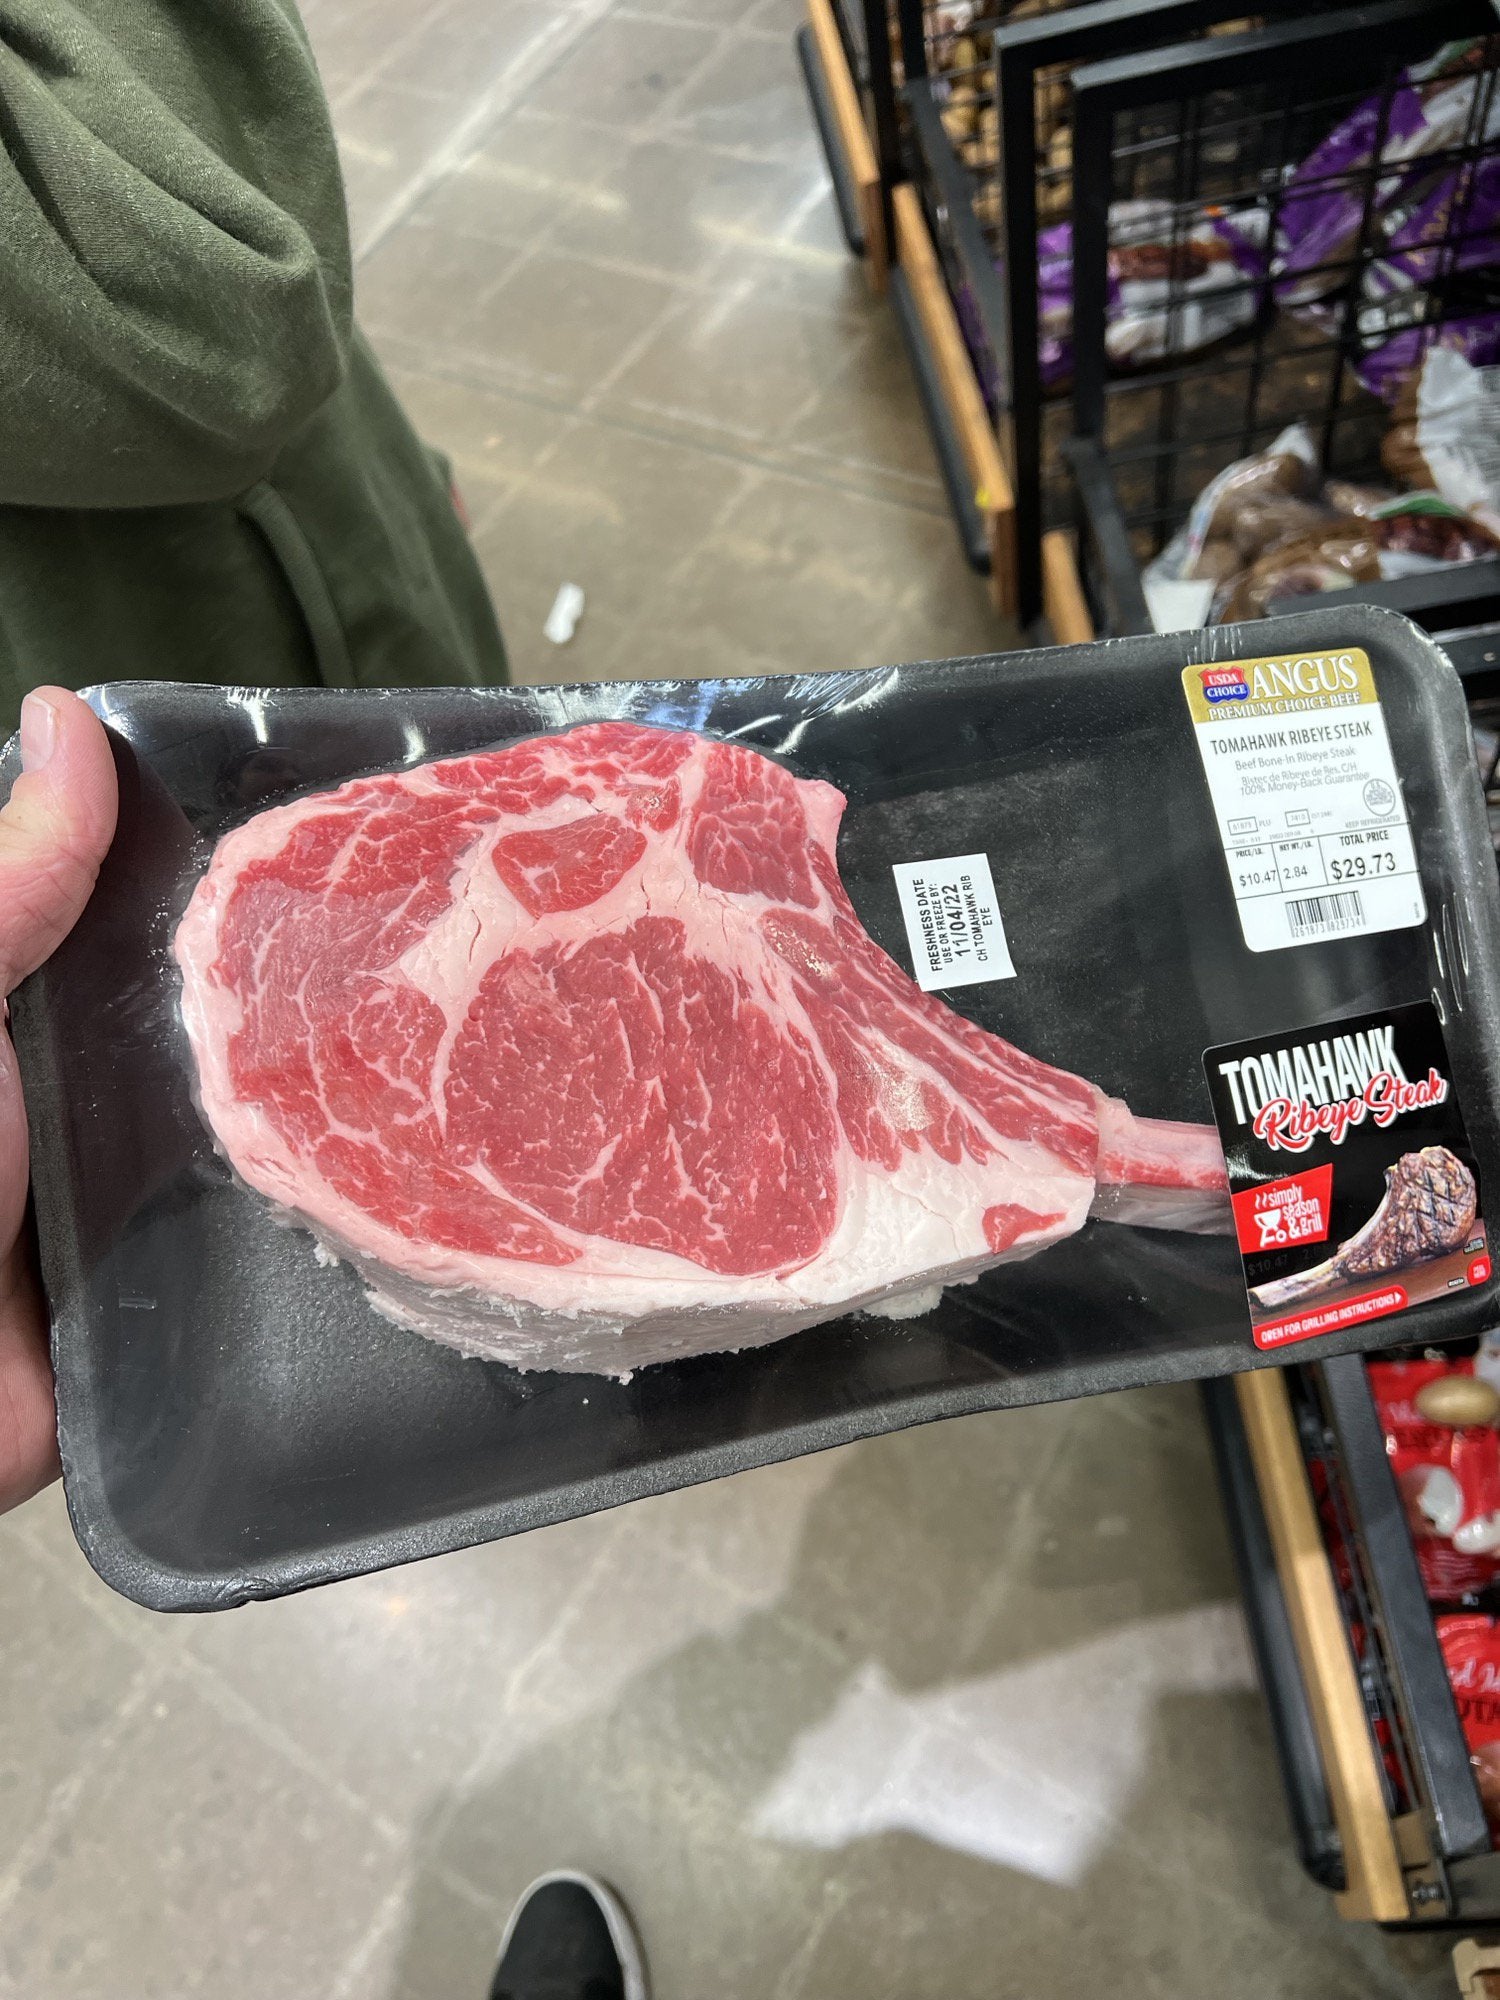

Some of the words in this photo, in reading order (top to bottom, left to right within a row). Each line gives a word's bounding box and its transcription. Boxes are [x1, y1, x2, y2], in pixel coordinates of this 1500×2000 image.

[1208, 674, 1239, 685] USDA
[1252, 655, 1358, 699] ANGUS
[1207, 685, 1247, 697] CHOICE
[1208, 701, 1274, 721] PREMIUM
[1276, 697, 1328, 714] CHOICE
[1330, 692, 1360, 706] BEEF
[1210, 731, 1287, 755] TOMAHAWK
[1290, 726, 1333, 745] RIBEYE
[1336, 721, 1373, 739] STEAK
[1235, 759, 1256, 771] Beef
[1258, 754, 1295, 768] Bone-In
[1297, 750, 1328, 765] Ribeye
[1330, 746, 1356, 757] Steak
[1240, 784, 1266, 797] 100%
[1268, 776, 1322, 793] Money-Back
[1325, 772, 1369, 786] Guarantee
[1241, 775, 1267, 786] Bistec
[1269, 773, 1280, 783] de
[1282, 769, 1310, 782] Ribeye
[1311, 768, 1322, 777] de
[1341, 762, 1357, 772] C/H
[1345, 819, 1360, 829] KEEP
[1361, 815, 1401, 826] REFRIGERATED
[1340, 833, 1364, 847] TOTAL
[1367, 830, 1389, 843] PRICE
[1239, 870, 1277, 887] $10.47
[1283, 865, 1308, 879] 2.84
[1331, 852, 1396, 881] $29.73
[913, 878, 928, 906] DATE
[928, 883, 939, 897] BY:
[960, 875, 973, 891] RIB
[932, 900, 946, 931] FREEZE
[942, 884, 970, 957] 11/04/22
[964, 893, 984, 947] TOMAHAWK
[981, 907, 993, 926] EYE
[920, 909, 943, 972] FRESHNESS
[939, 932, 949, 945] OR
[942, 947, 953, 963] USE
[976, 949, 988, 961] CH
[1219, 1026, 1405, 1125] TOMAHAWK
[1253, 1096, 1364, 1152] Ribeye
[1362, 1068, 1448, 1126] Steak
[1268, 1183, 1303, 1207] simply
[1283, 1198, 1319, 1219] season
[1285, 1322, 1301, 1337] FOR
[1302, 1311, 1339, 1331] GRILLING
[1340, 1293, 1395, 1320] INSTRUCTIONS
